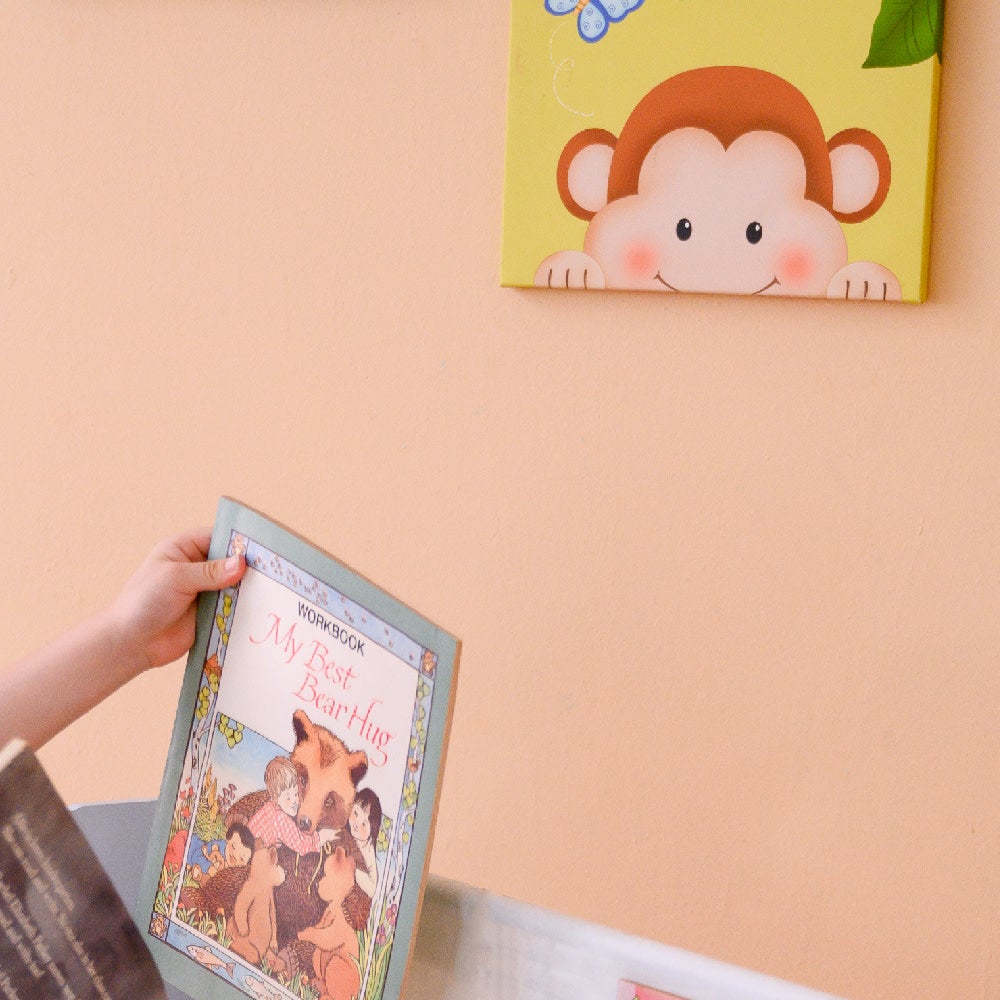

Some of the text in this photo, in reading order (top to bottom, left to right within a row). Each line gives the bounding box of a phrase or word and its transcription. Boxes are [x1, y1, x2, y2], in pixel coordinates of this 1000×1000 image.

[249, 613, 361, 690] My Best
[298, 602, 365, 656] WORKBOOK
[292, 672, 397, 767] Bear Hug
